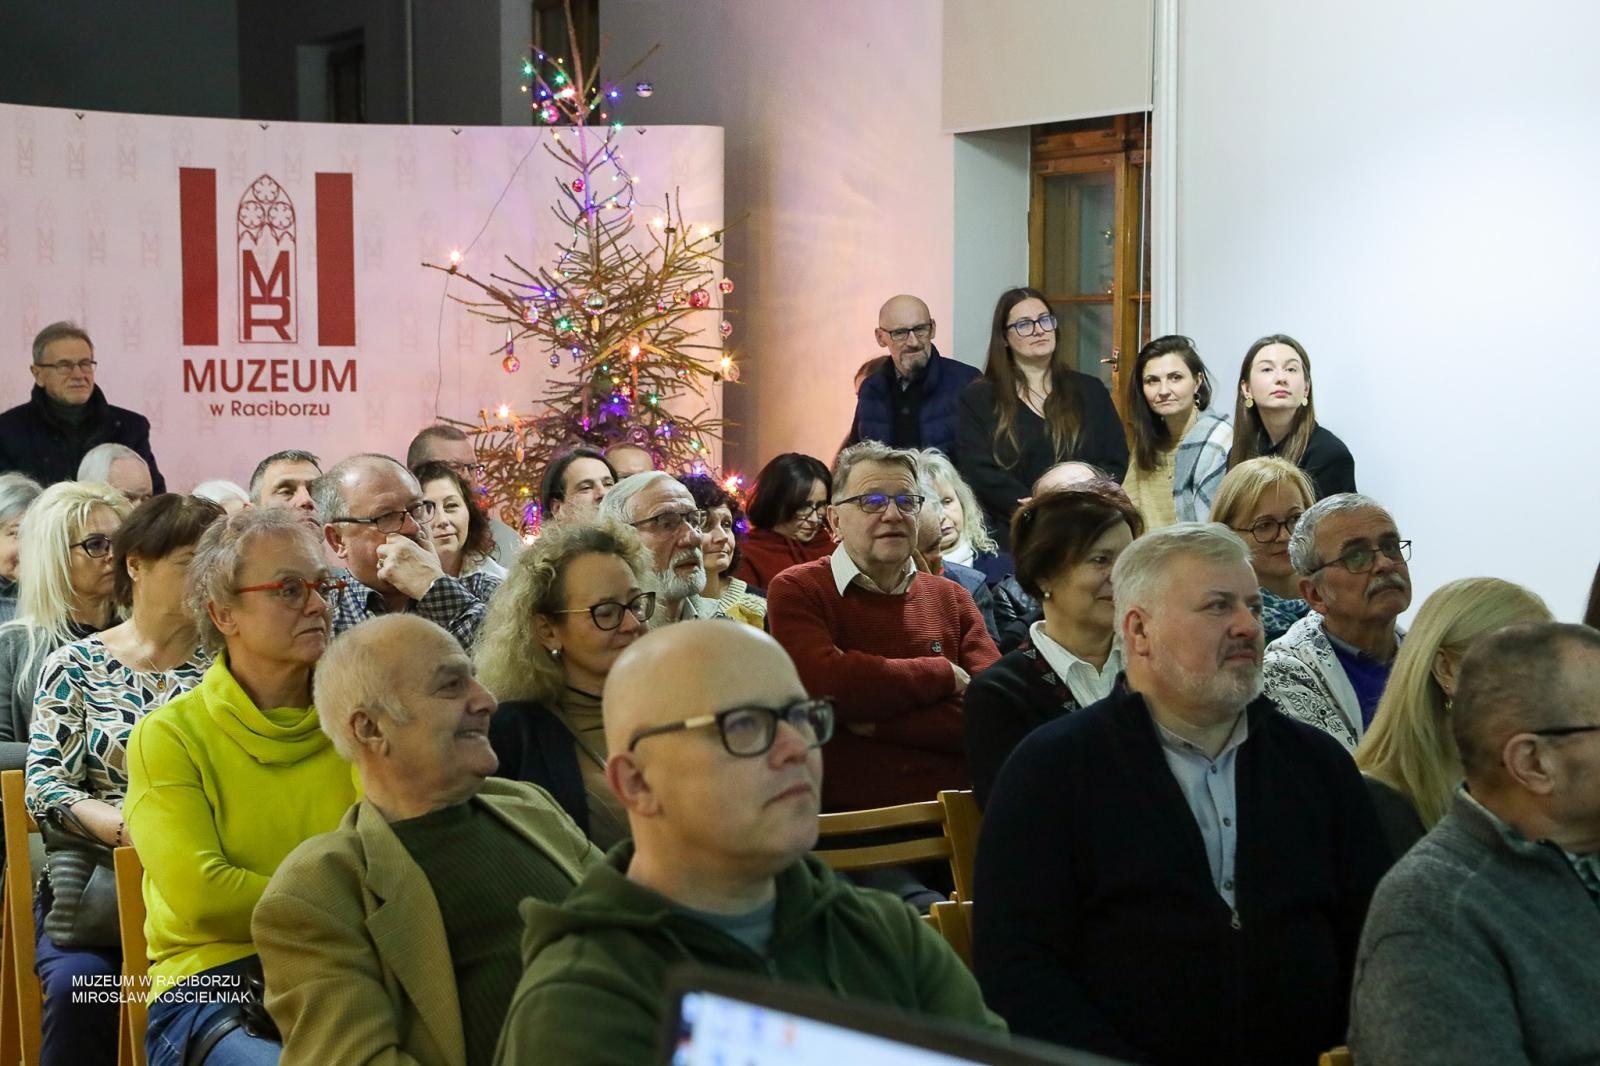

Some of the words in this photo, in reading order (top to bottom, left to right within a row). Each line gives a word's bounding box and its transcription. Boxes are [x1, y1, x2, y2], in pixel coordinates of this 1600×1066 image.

[183, 359, 357, 393] MUZEUM
[210, 404, 224, 416] w
[231, 400, 330, 416] Raciborzu
